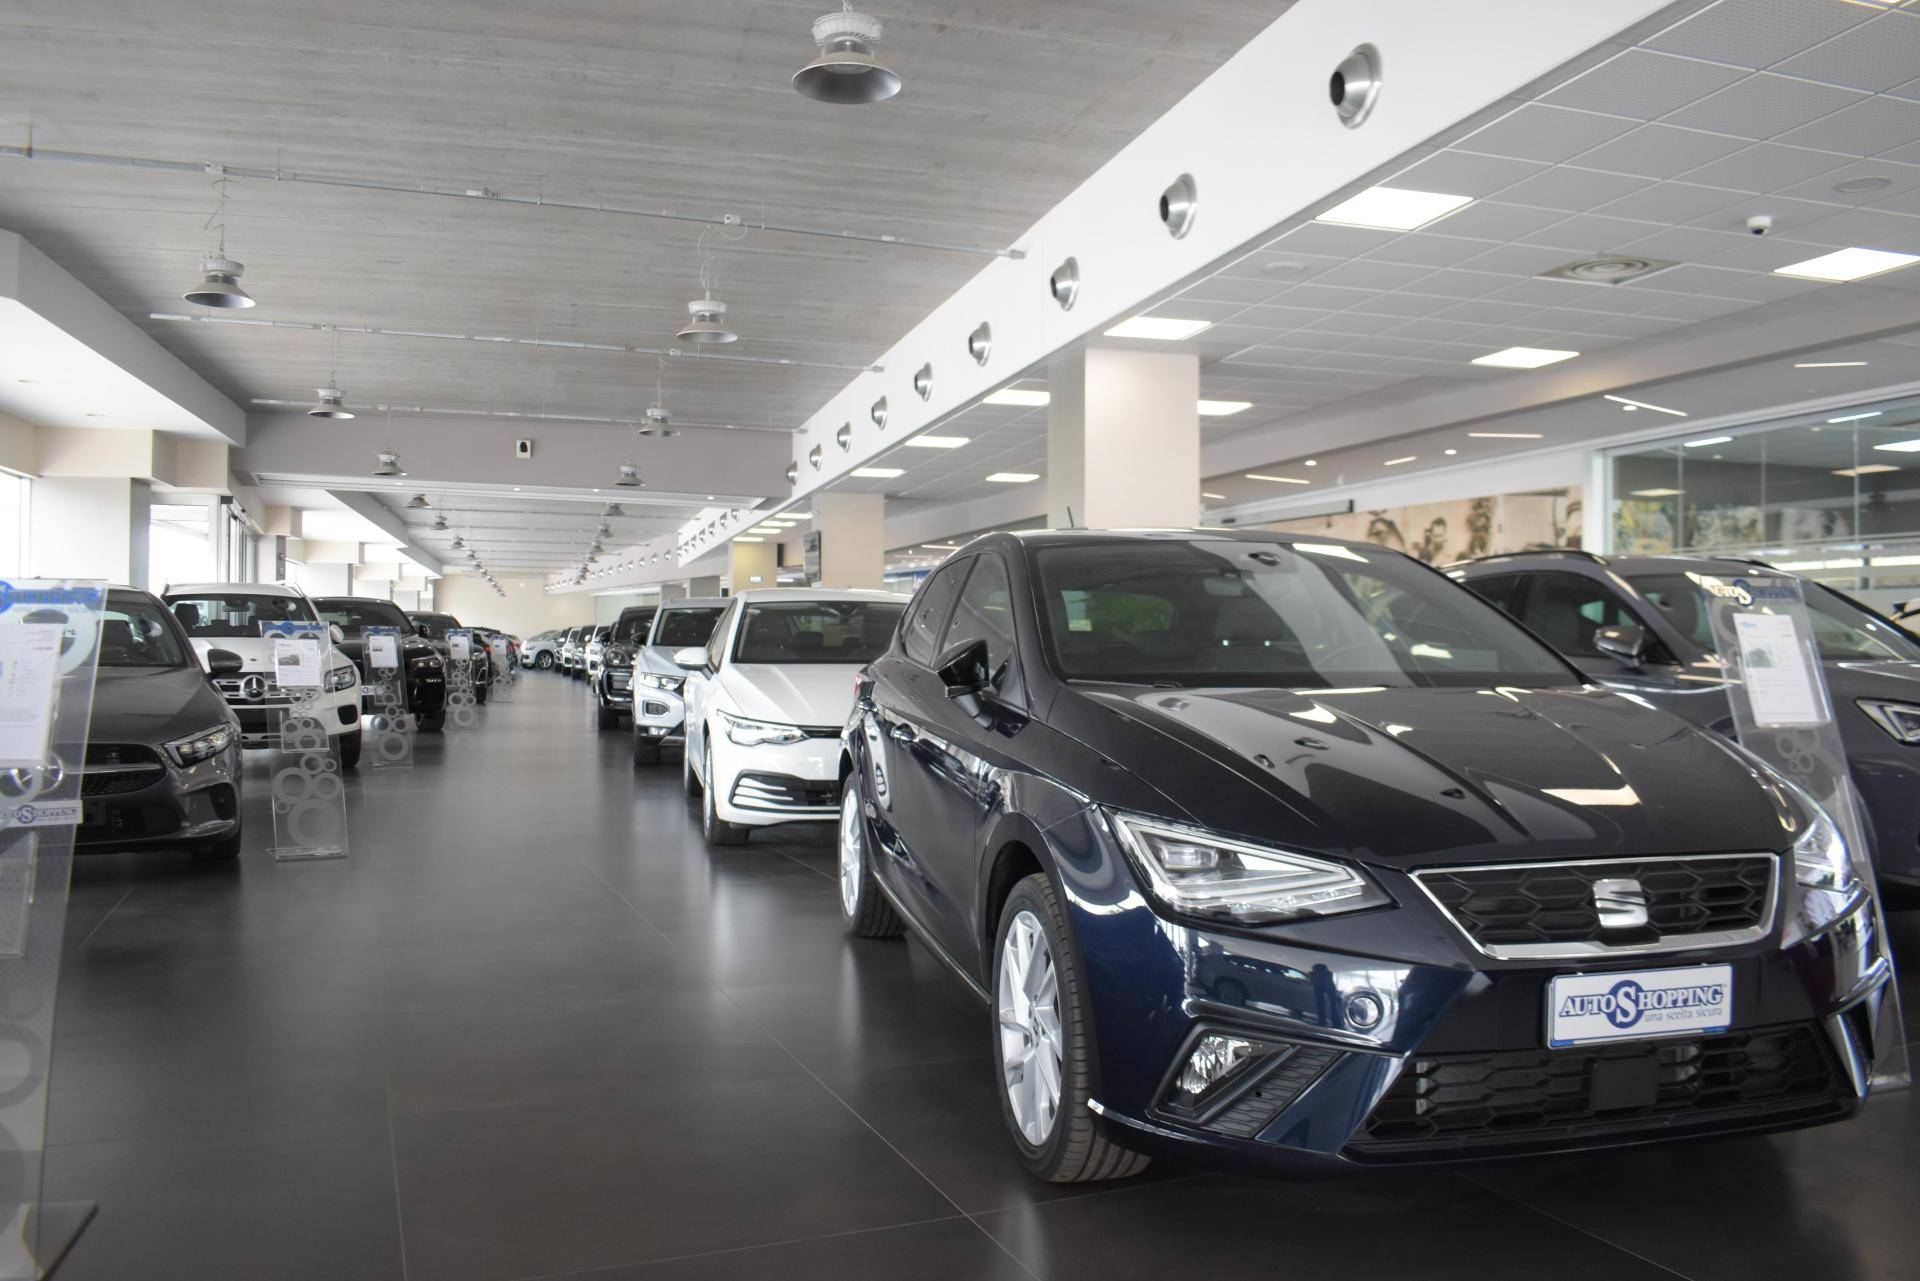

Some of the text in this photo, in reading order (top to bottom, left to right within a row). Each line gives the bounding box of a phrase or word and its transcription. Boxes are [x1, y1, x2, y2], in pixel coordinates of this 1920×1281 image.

[1559, 983, 1724, 1025] AUTOSHOPPING
[1645, 1006, 1723, 1023] una scelta sicura
